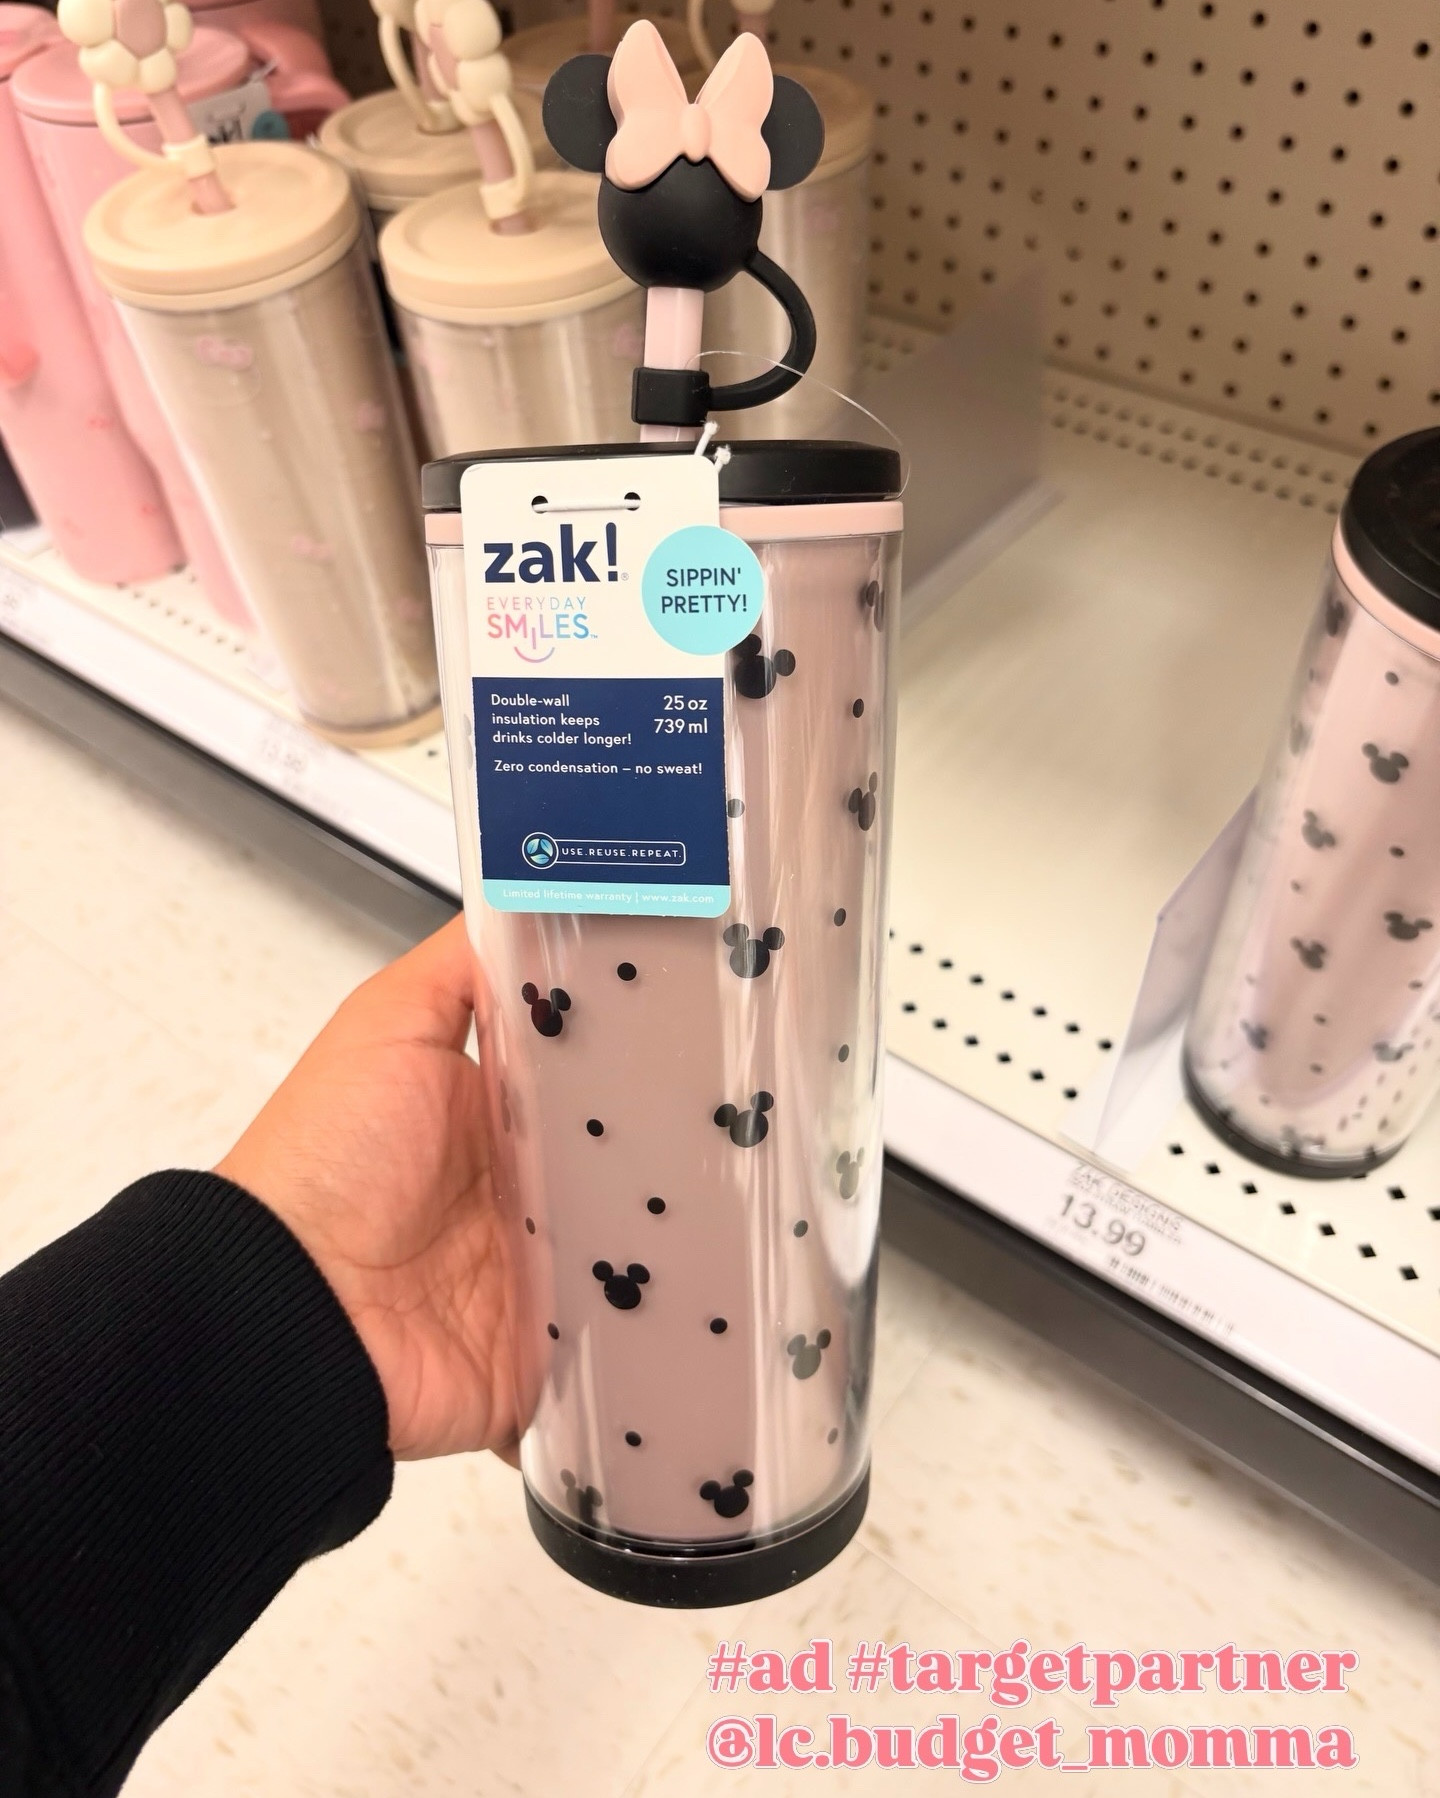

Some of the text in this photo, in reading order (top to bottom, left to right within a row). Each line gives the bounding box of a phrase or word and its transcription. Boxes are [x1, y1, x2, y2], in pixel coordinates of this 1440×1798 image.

[483, 522, 618, 584] zak!
[666, 567, 742, 587] SIPPIN'
[487, 596, 586, 611] EVERYDAY
[661, 594, 747, 614] PRETTY!
[491, 694, 570, 707] Double-wall
[663, 695, 708, 711] 25 oz
[492, 713, 600, 729] insulation keeps
[654, 718, 708, 734] 739 ml
[493, 731, 632, 748] drinks colder longer!
[494, 760, 524, 772] Zero
[528, 761, 618, 774] condensation
[635, 763, 652, 774] no
[657, 763, 702, 775] sweat!
[503, 888, 541, 899] Limited
[543, 889, 583, 901] lifetime
[586, 892, 632, 904] warranty
[642, 893, 714, 903] www.zak.com
[1060, 1194, 1146, 1256] 13.99
